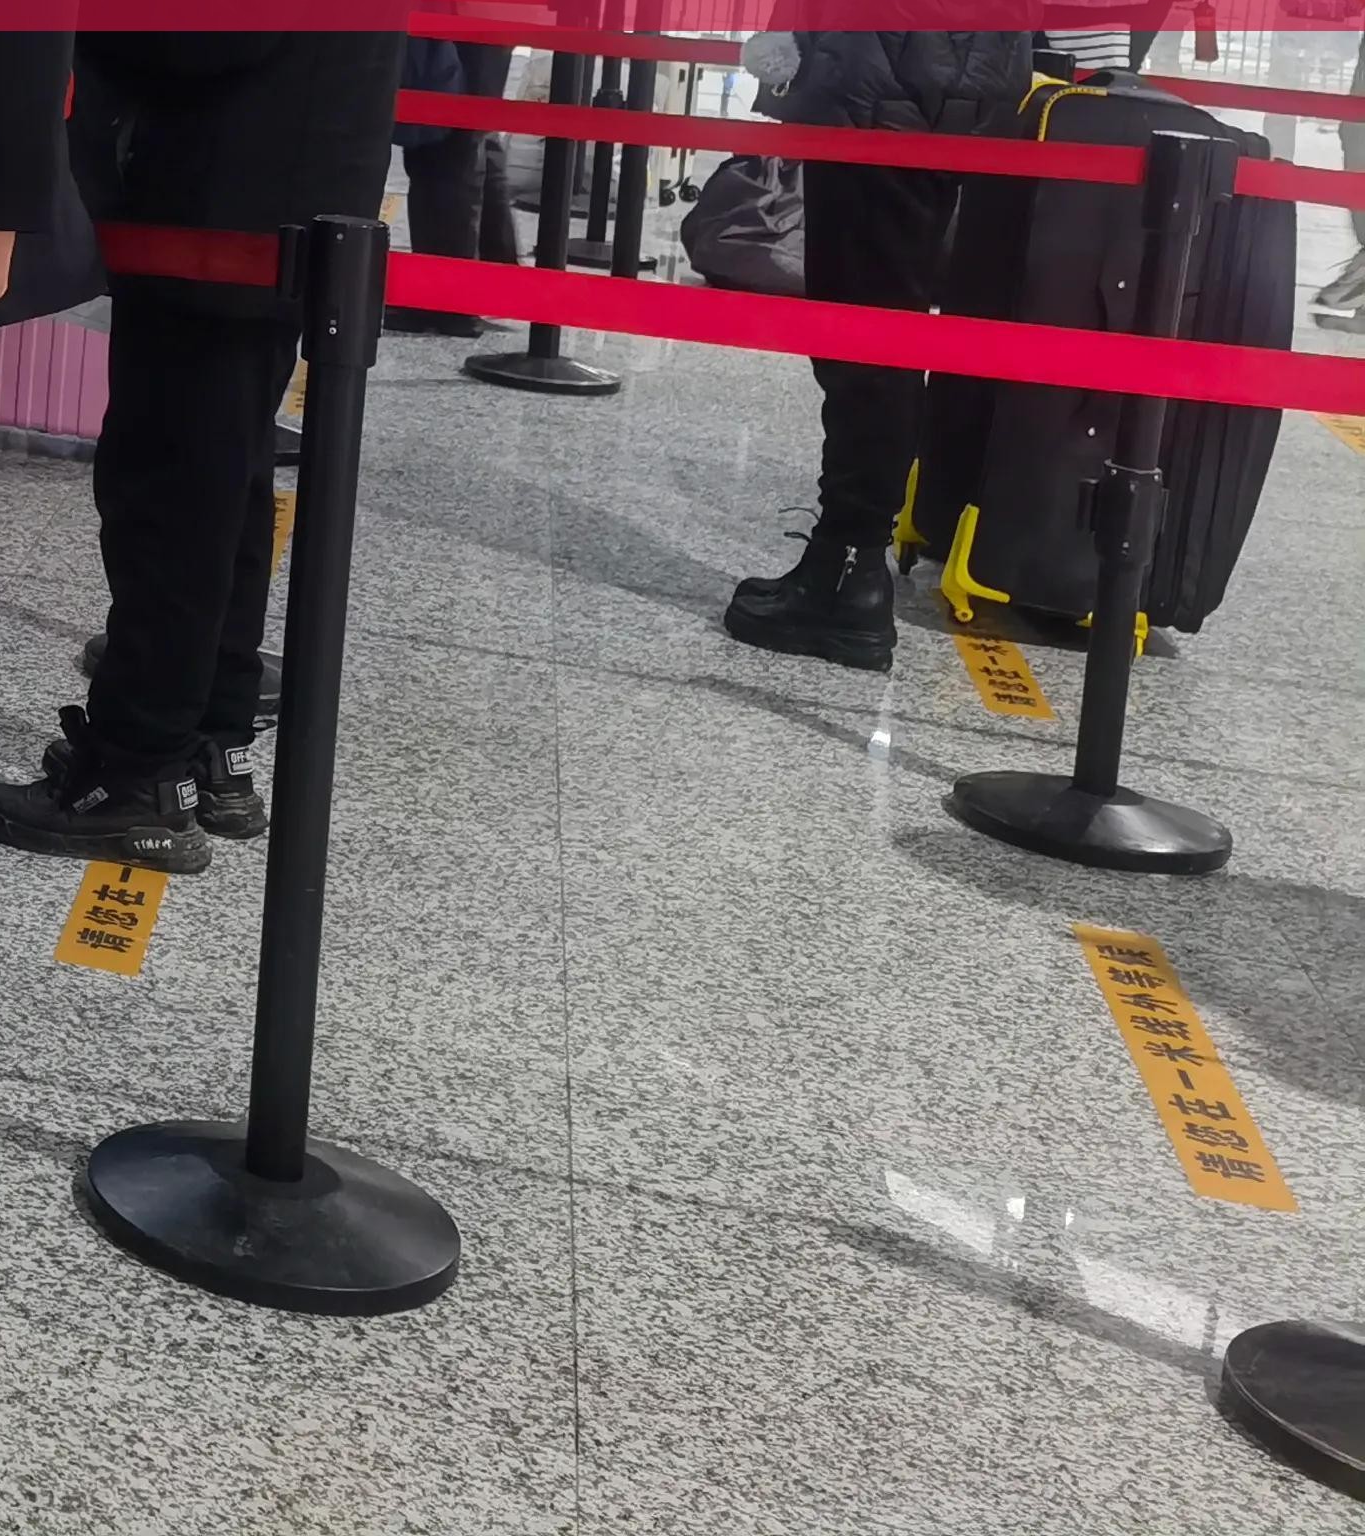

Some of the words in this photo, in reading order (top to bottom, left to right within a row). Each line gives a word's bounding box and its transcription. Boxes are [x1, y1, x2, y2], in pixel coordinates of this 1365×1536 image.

[1095, 944, 1266, 1183] 请您在一米线外等候
